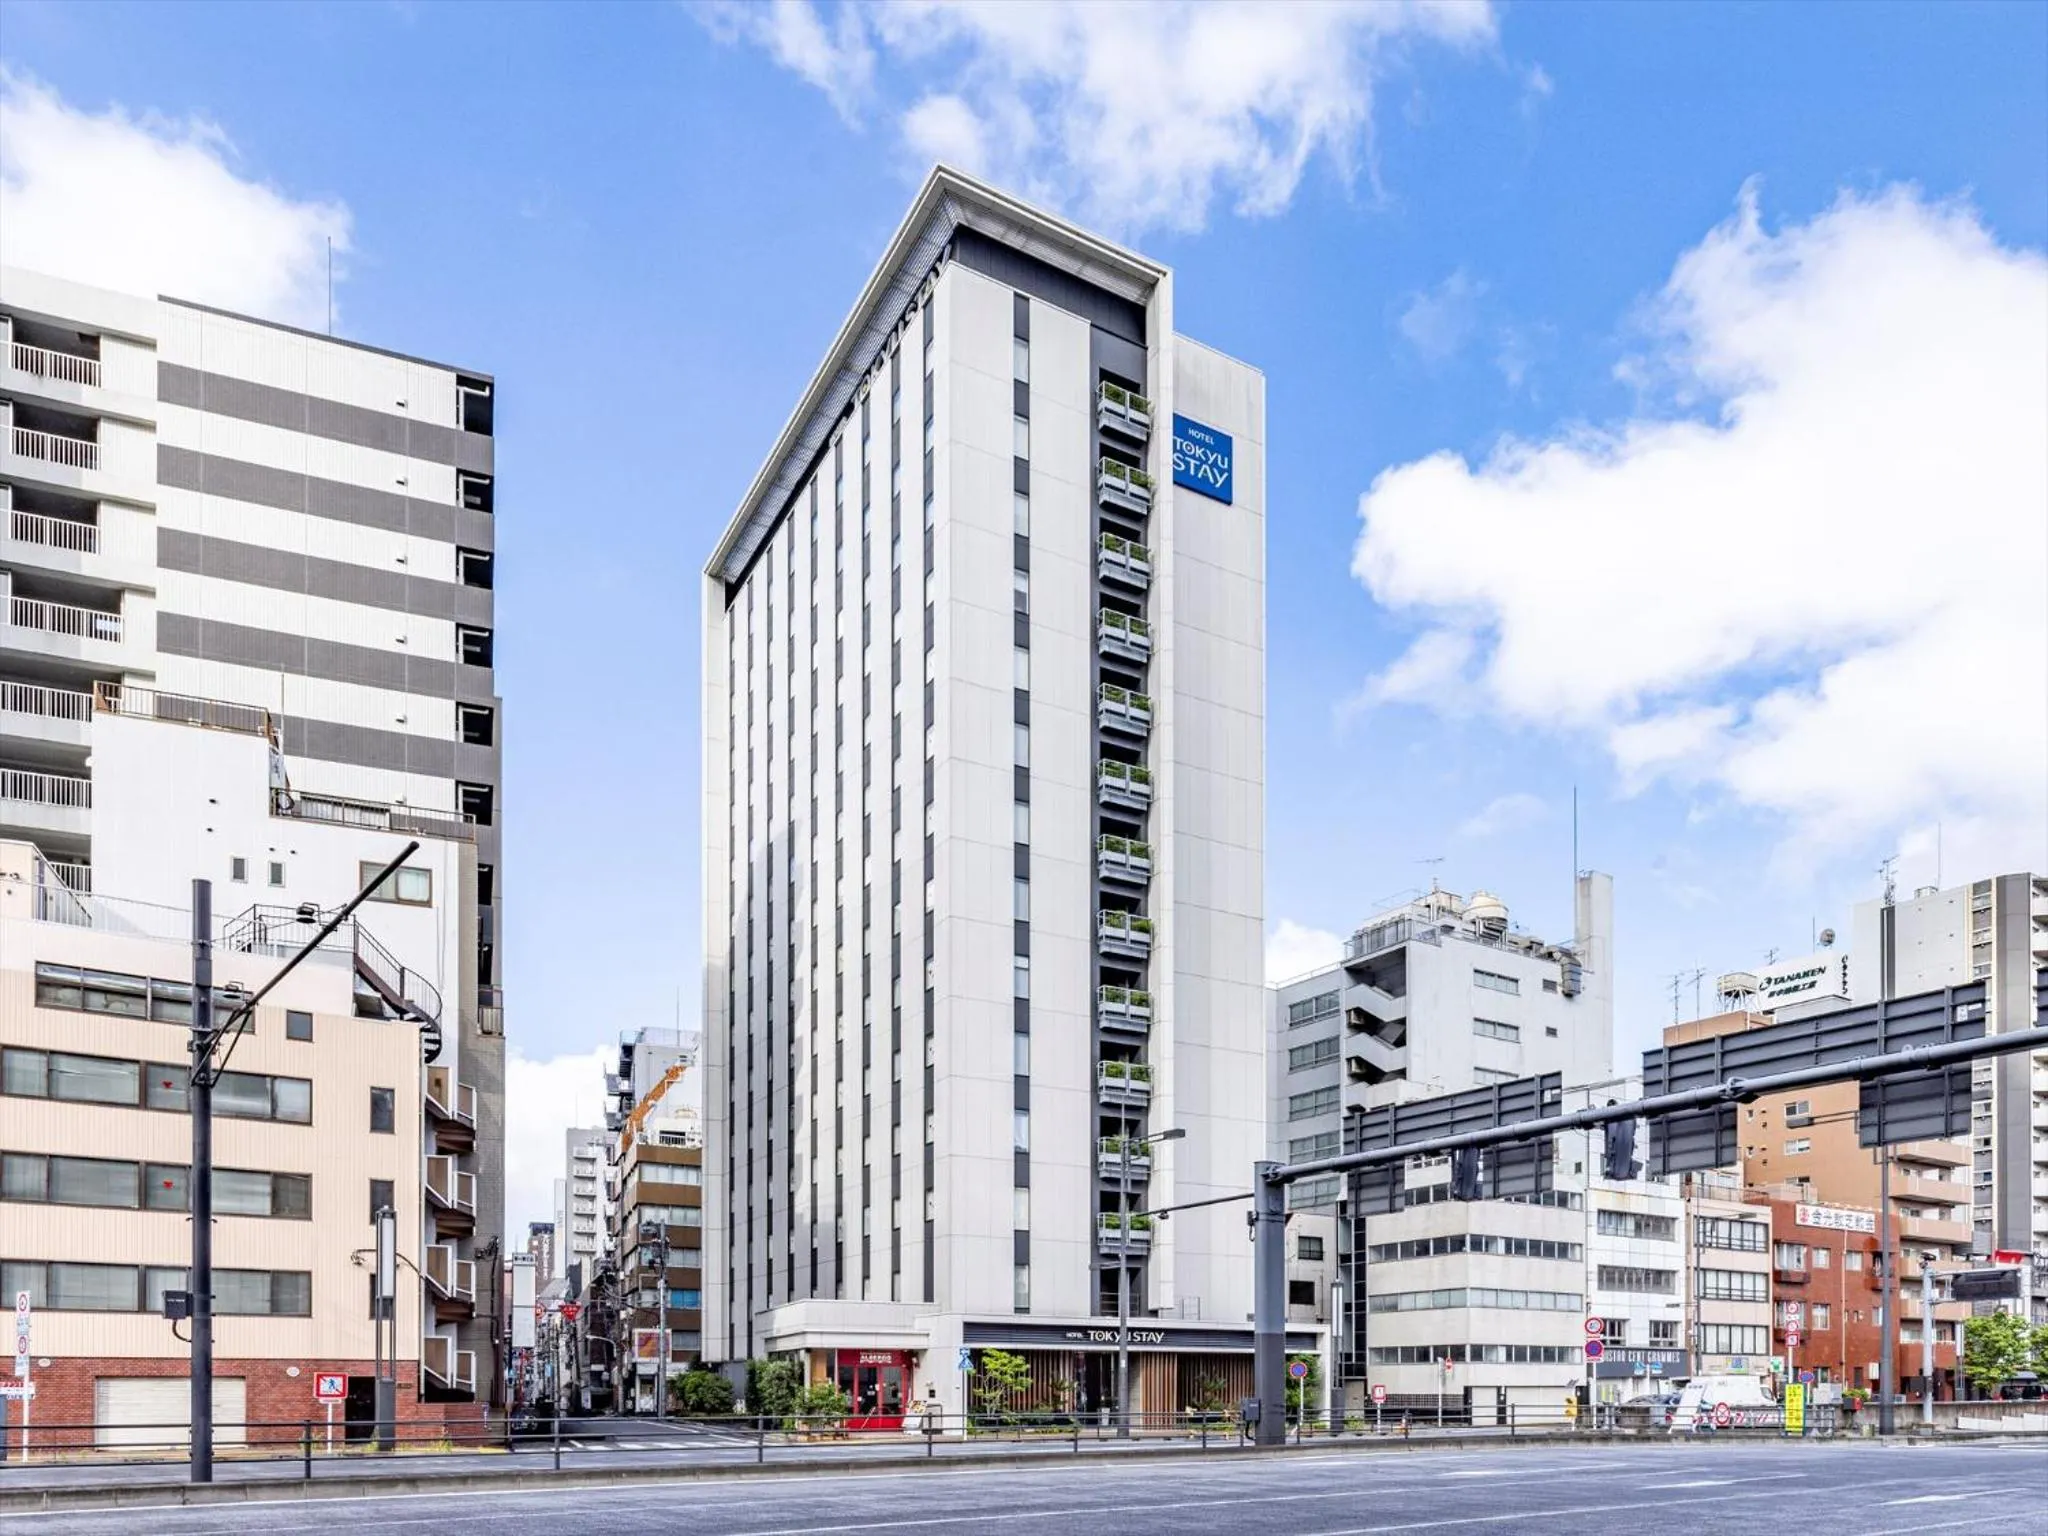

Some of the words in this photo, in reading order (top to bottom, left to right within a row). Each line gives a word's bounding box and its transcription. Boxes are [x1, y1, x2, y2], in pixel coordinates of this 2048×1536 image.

[1188, 427, 1214, 446] HOTEL
[1173, 436, 1229, 469] TOKYU
[1173, 452, 1229, 488] STAY
[1773, 966, 1826, 985] TANAKEN
[1133, 1331, 1164, 1344] STAY
